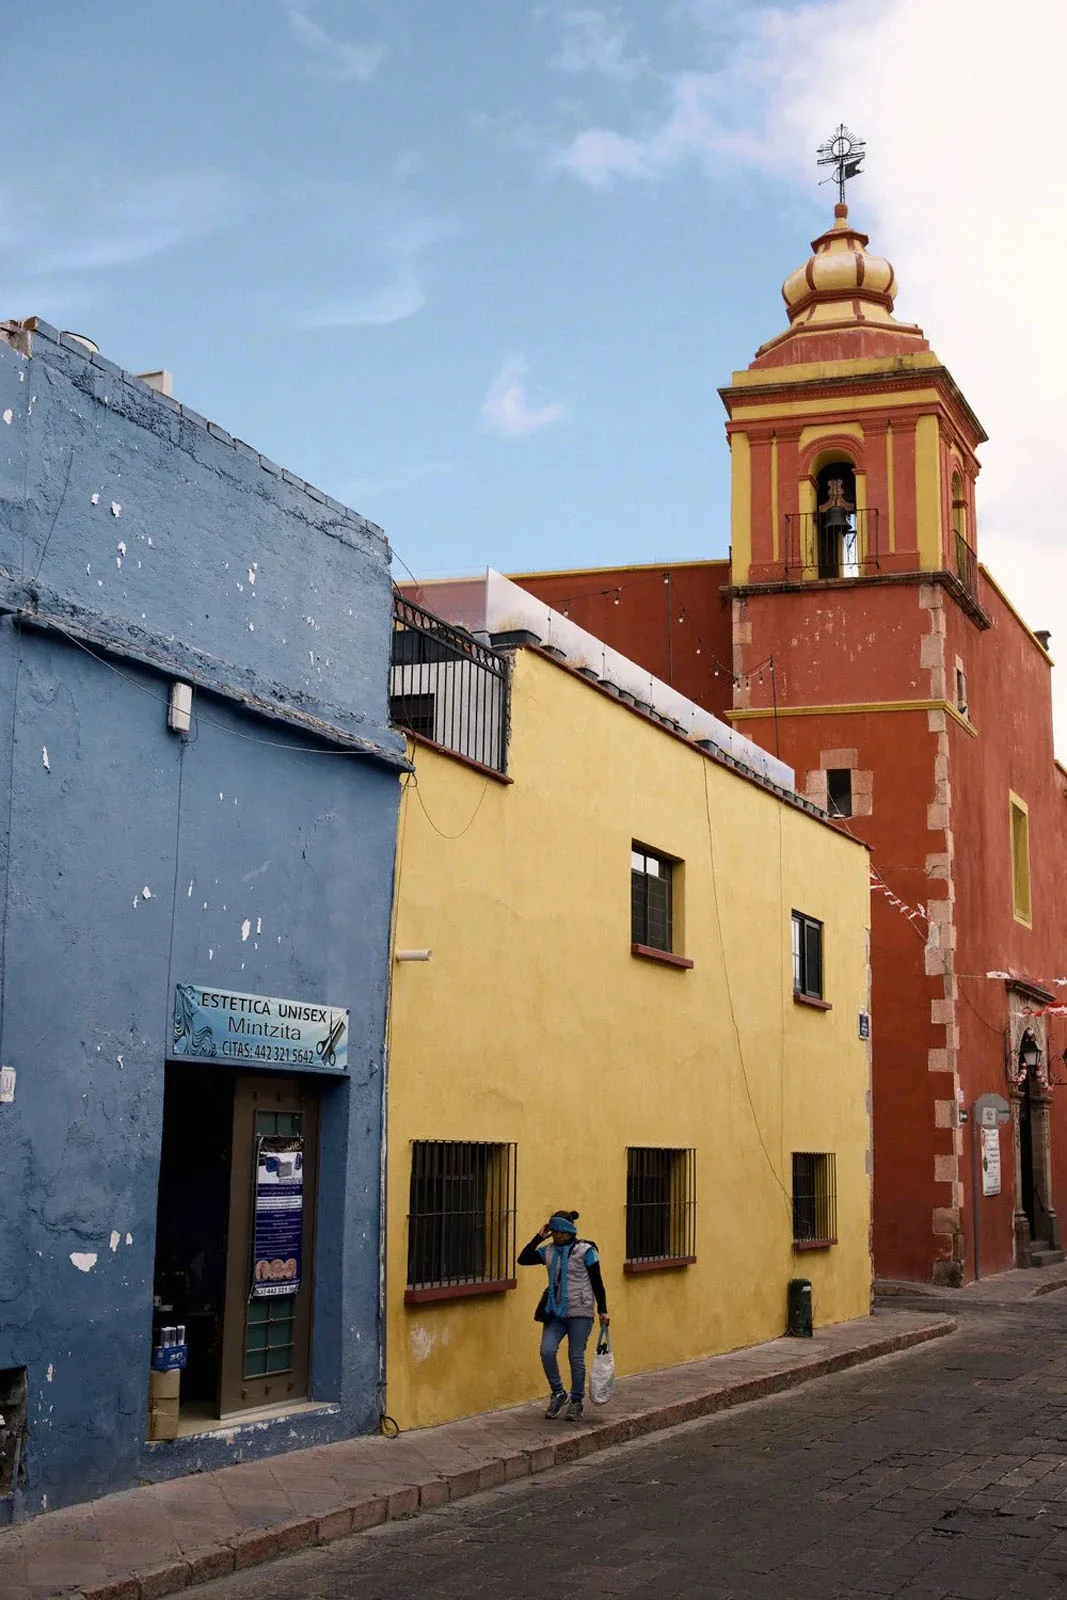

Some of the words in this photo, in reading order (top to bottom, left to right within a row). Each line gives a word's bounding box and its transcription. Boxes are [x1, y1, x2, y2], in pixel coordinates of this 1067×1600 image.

[201, 993, 271, 1015] ESTETICA
[279, 1005, 328, 1023] UNISEX
[228, 1017, 301, 1041] Mintzita
[222, 1041, 252, 1058] CITAS:
[254, 1045, 272, 1060] 442
[273, 1047, 290, 1062] 321
[292, 1049, 313, 1064] 5642
